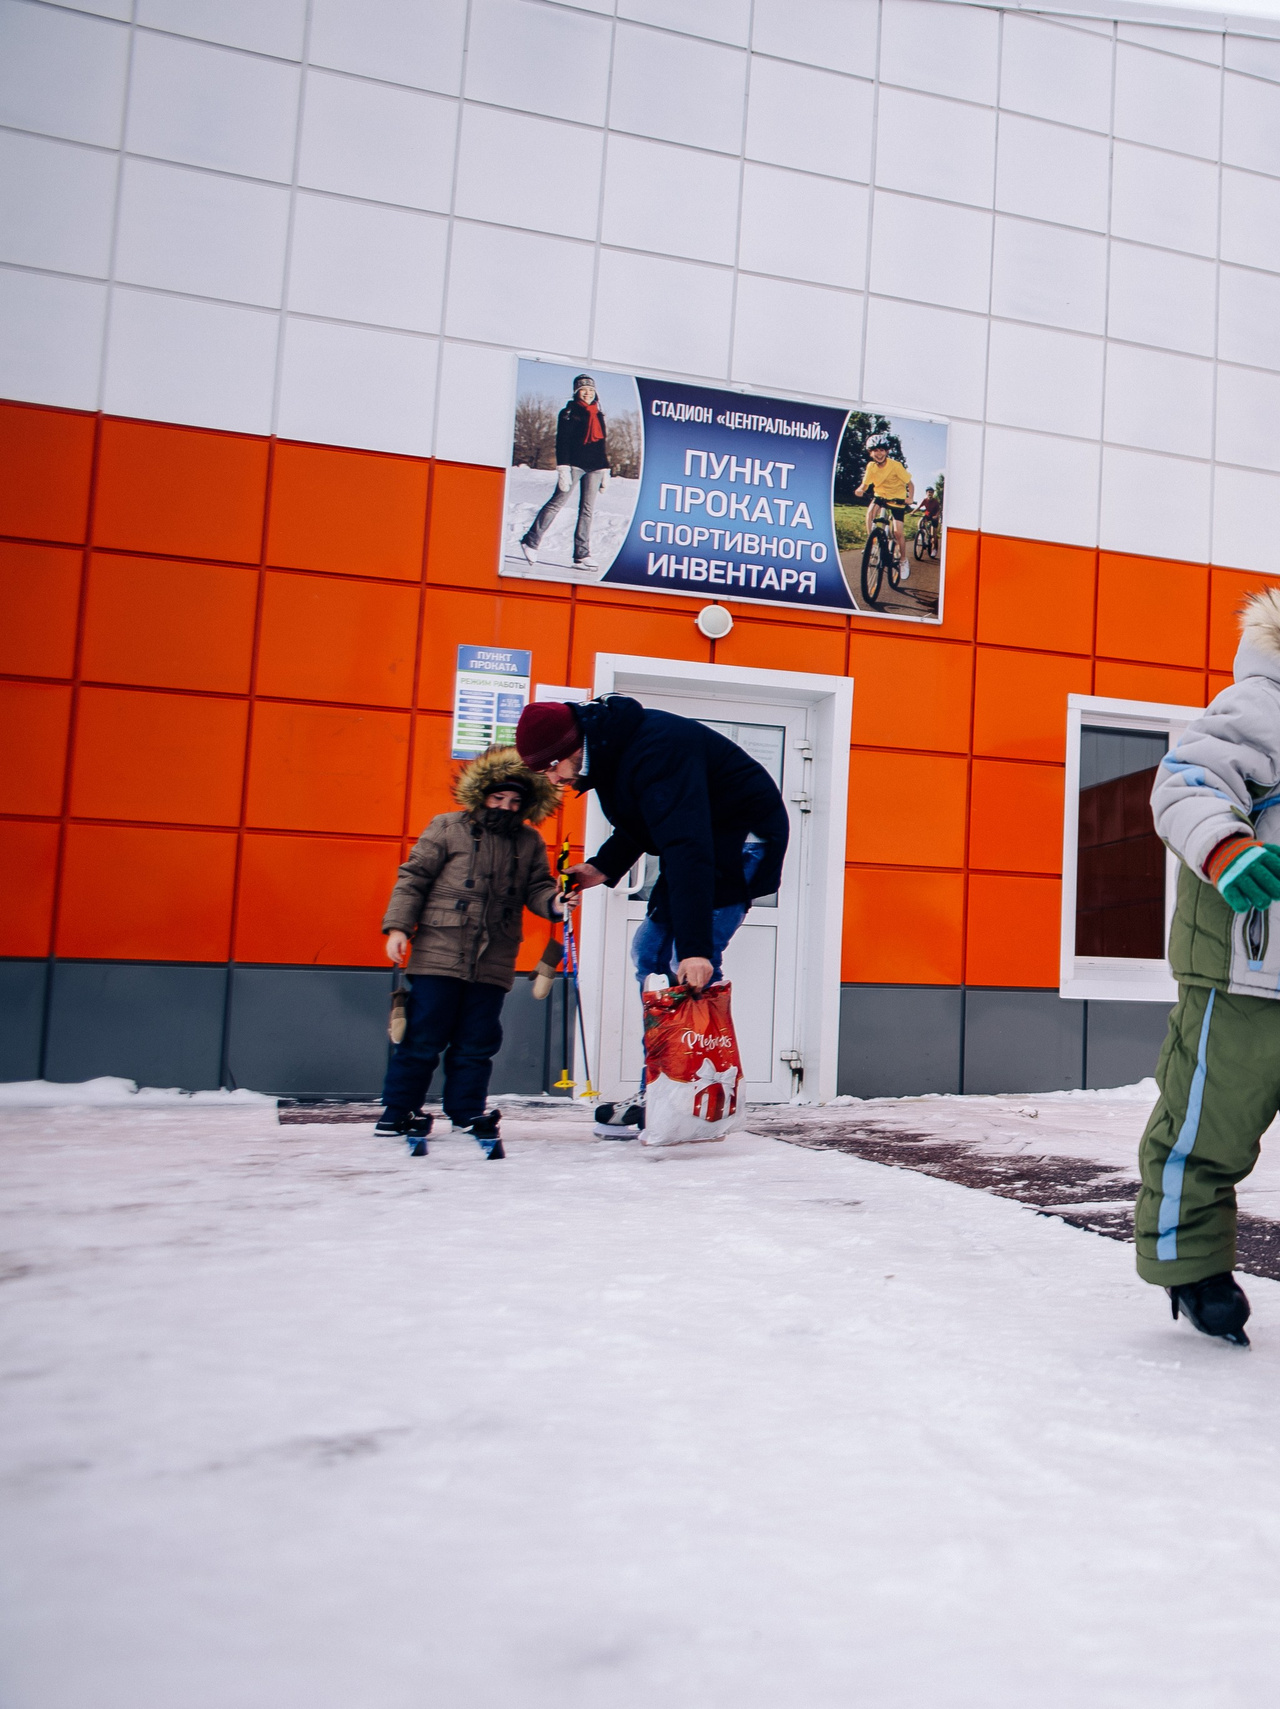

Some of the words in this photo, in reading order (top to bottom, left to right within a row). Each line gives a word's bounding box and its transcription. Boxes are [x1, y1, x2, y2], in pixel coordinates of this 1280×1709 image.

[651, 399, 713, 424] СТАДИОН
[716, 410, 830, 441] «ЦЕНТРАЛЬНЫЙ»
[684, 448, 796, 490] ПУНКТ
[658, 483, 814, 530] ПРОКАТА
[639, 520, 828, 563] СПОРТИВНОГО
[647, 552, 817, 595] ИНВЕНТАРЯ
[469, 660, 518, 672] ПРОКАТА
[477, 651, 513, 662] ПУНКТ
[460, 677, 492, 687] РЕЖИМ
[494, 680, 526, 690] РАБОТЫ
